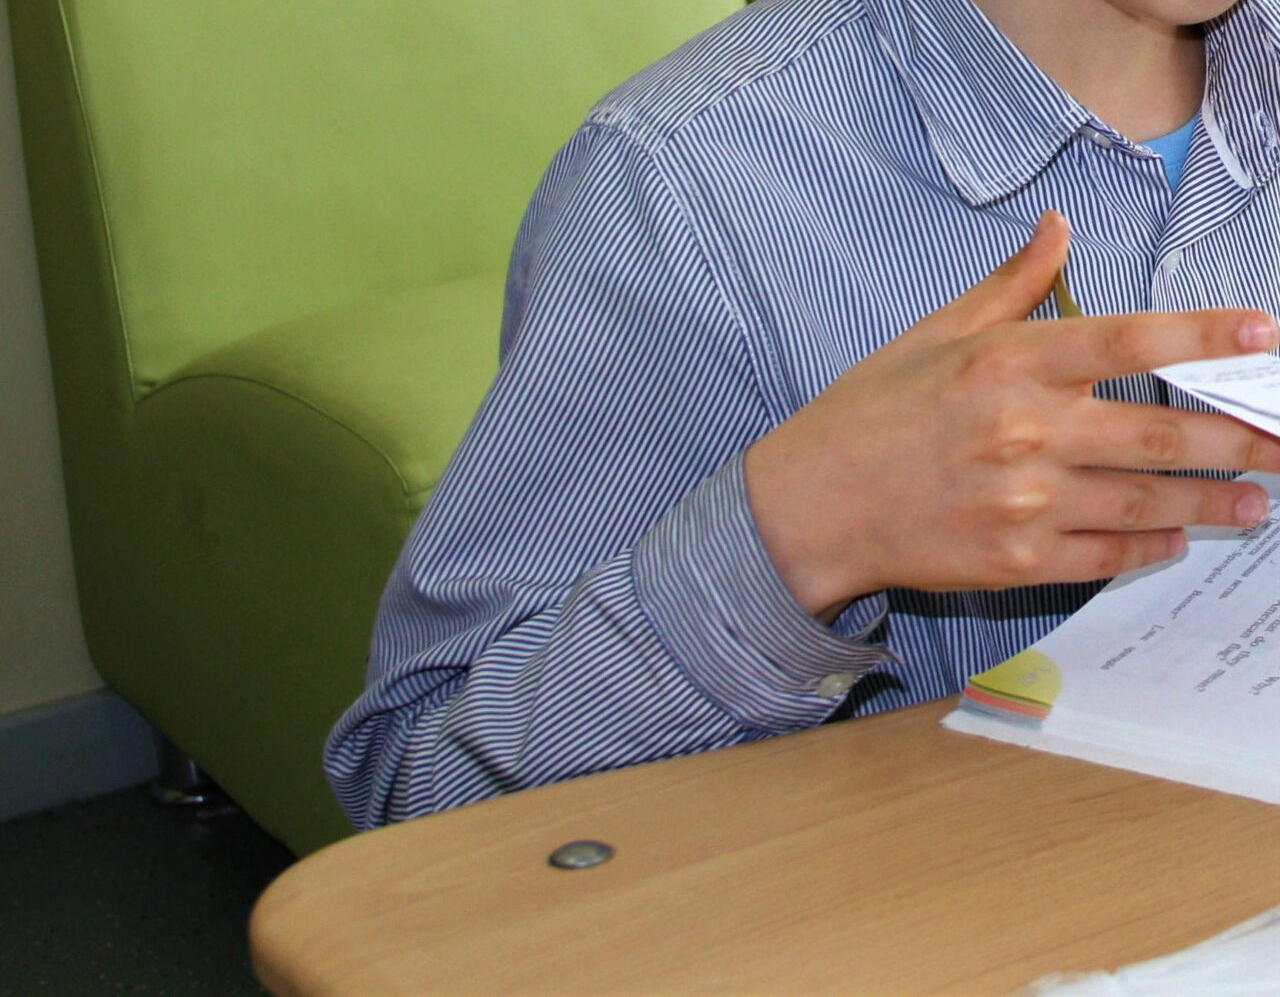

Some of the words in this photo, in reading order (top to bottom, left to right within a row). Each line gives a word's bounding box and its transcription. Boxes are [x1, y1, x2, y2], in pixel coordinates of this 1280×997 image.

[1202, 535, 1265, 584] Star-Spangled
[1215, 642, 1242, 661] flag?
[1224, 649, 1251, 666] they
[1250, 675, 1280, 695] Why?
